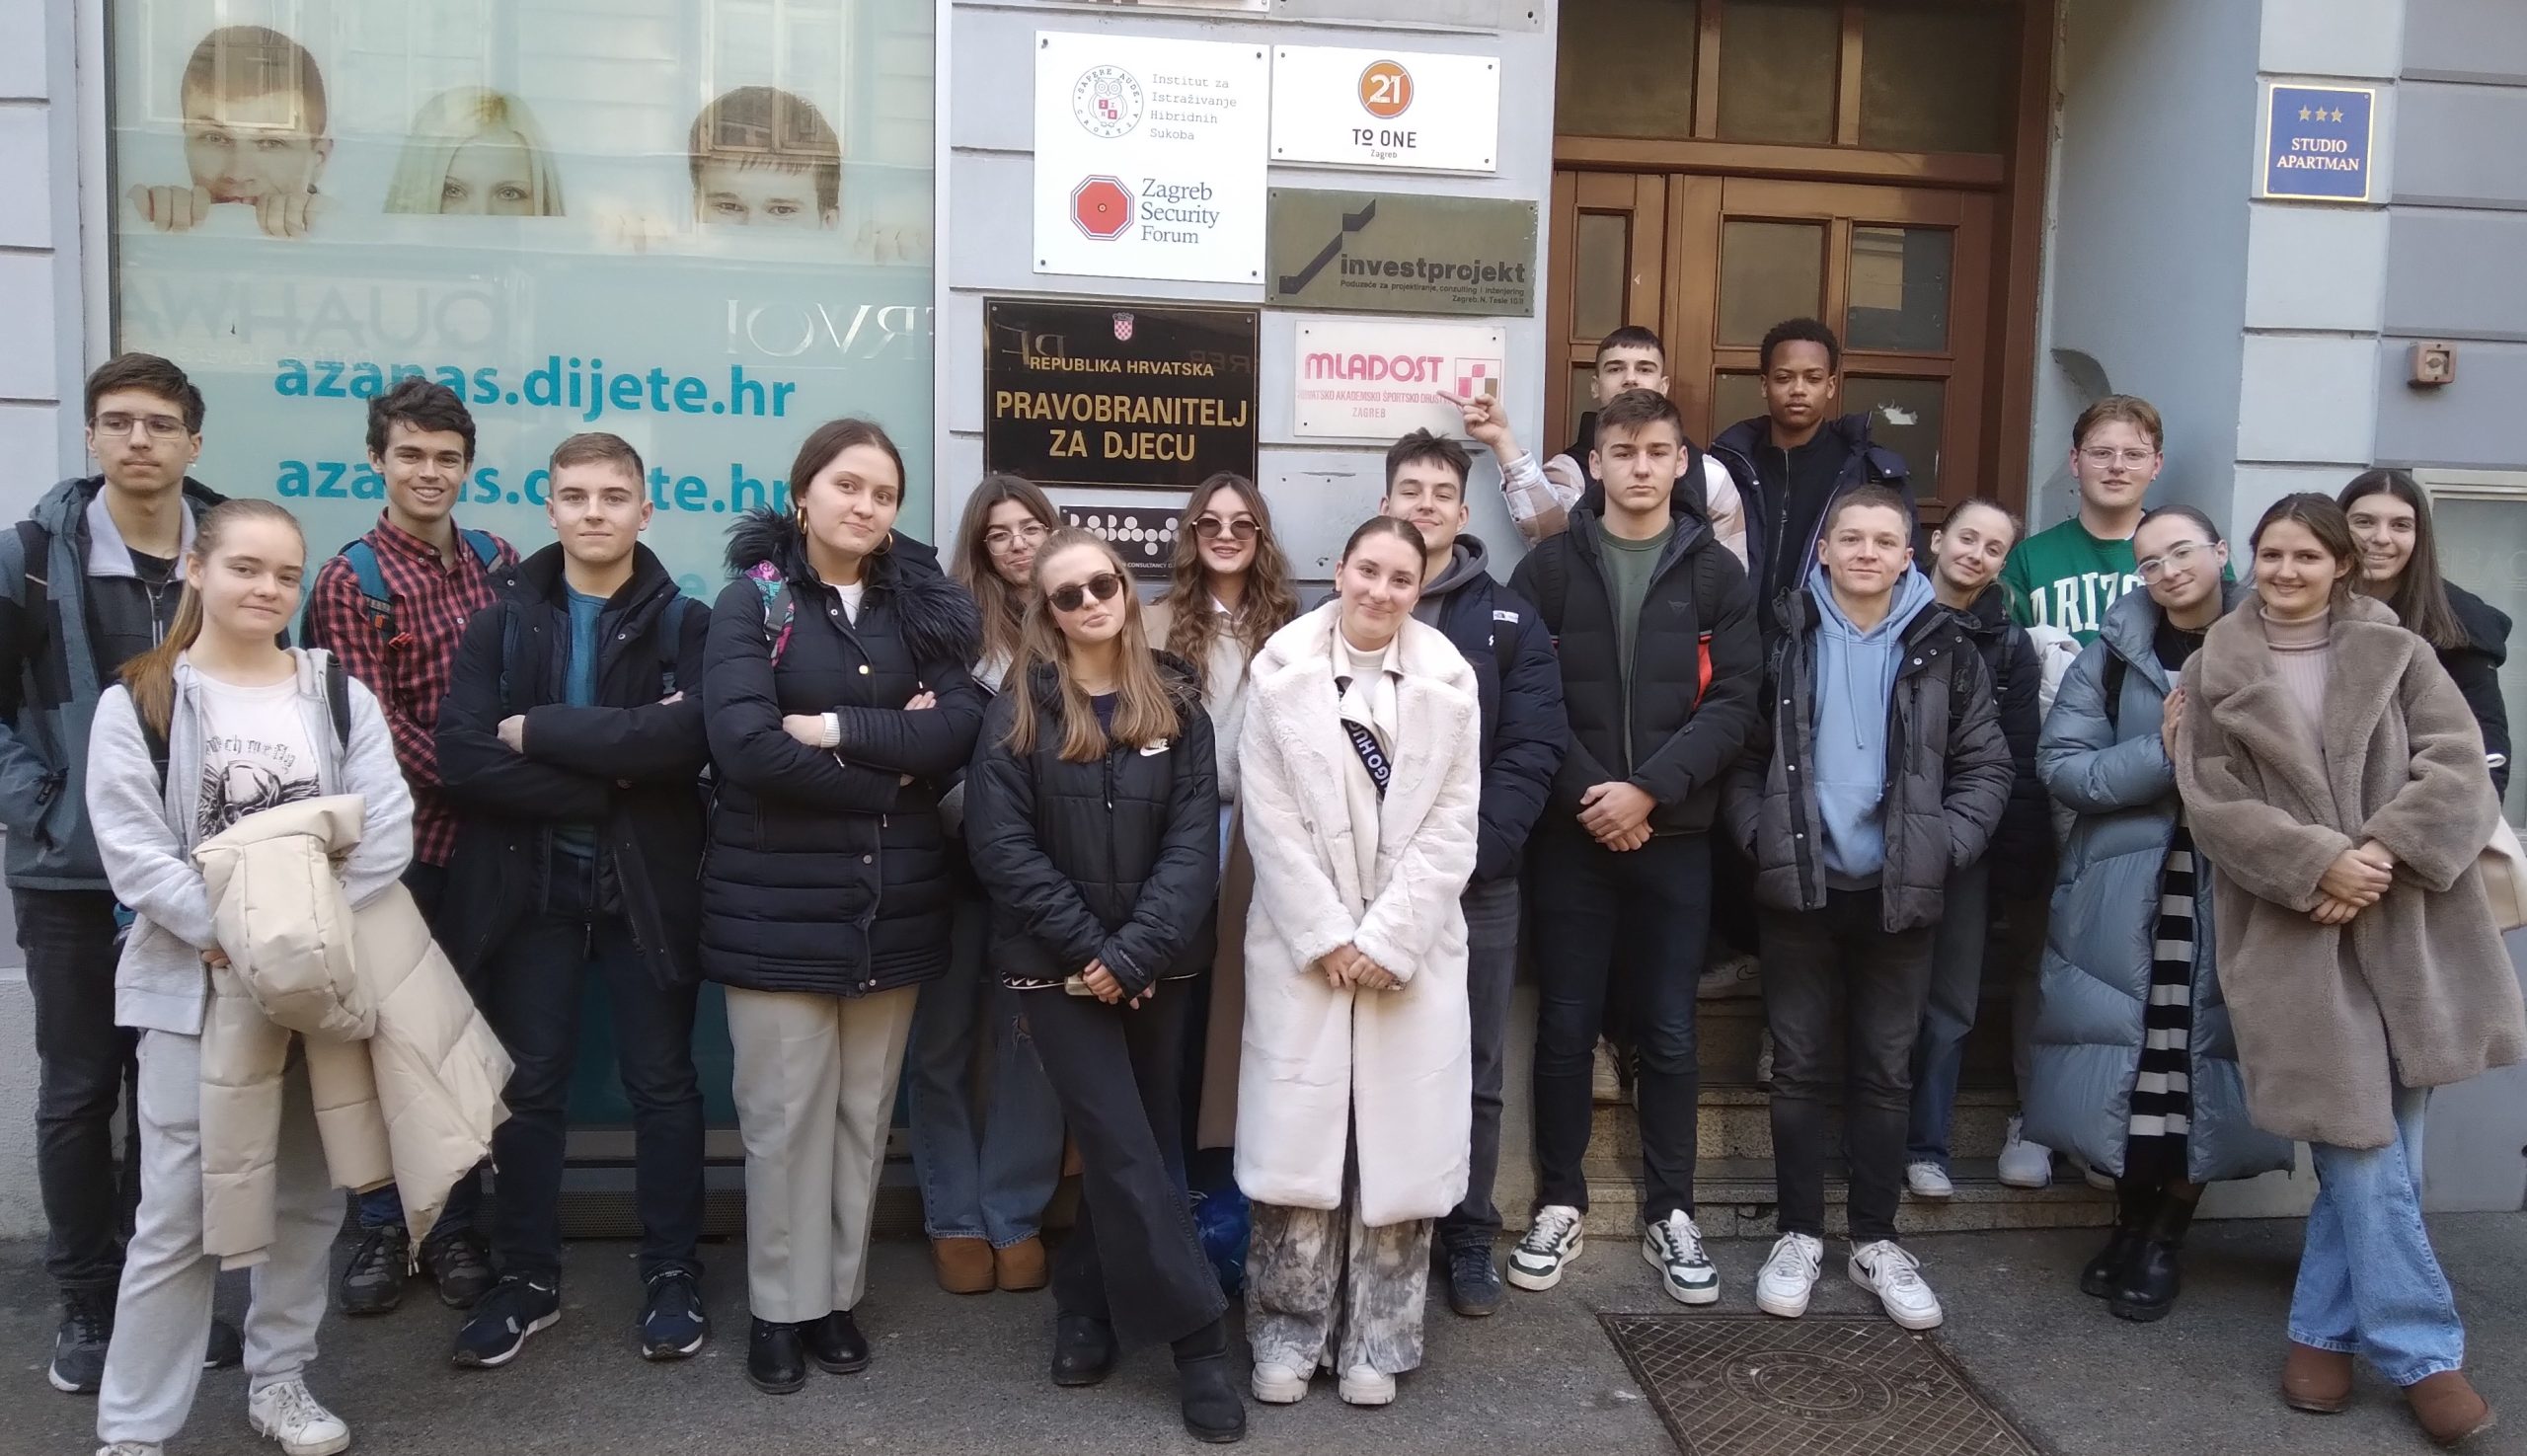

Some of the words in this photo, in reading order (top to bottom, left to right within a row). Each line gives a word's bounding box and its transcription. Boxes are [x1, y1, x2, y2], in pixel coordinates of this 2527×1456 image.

[1152, 74, 1209, 88] Institut
[1215, 79, 1230, 89] za
[1369, 74, 1401, 104] 21
[1151, 92, 1238, 109] Istraživanje
[1150, 110, 1218, 124] Hibridnih
[1150, 128, 1195, 140] Sukoba
[1381, 130, 1417, 148] ONE
[1371, 149, 1398, 160] Zagreb
[2291, 137, 2347, 153] STUDIO
[2276, 155, 2360, 171] APARTMAN
[1141, 178, 1213, 203] Zagreb
[1141, 201, 1220, 229] Security
[1141, 224, 1200, 244] Forum
[1340, 253, 1525, 284] investprojekt
[1031, 356, 1121, 373] REPUBLIKA
[1127, 361, 1214, 377] HRVATSKA
[1305, 352, 1444, 382] MLADOST
[996, 390, 1248, 427] PRAVOBRANITELJ
[1352, 407, 1386, 419] ZAGREB
[1049, 429, 1088, 457] ZA
[1104, 430, 1195, 461] DJECU
[276, 460, 791, 514] azas.dte.hr
